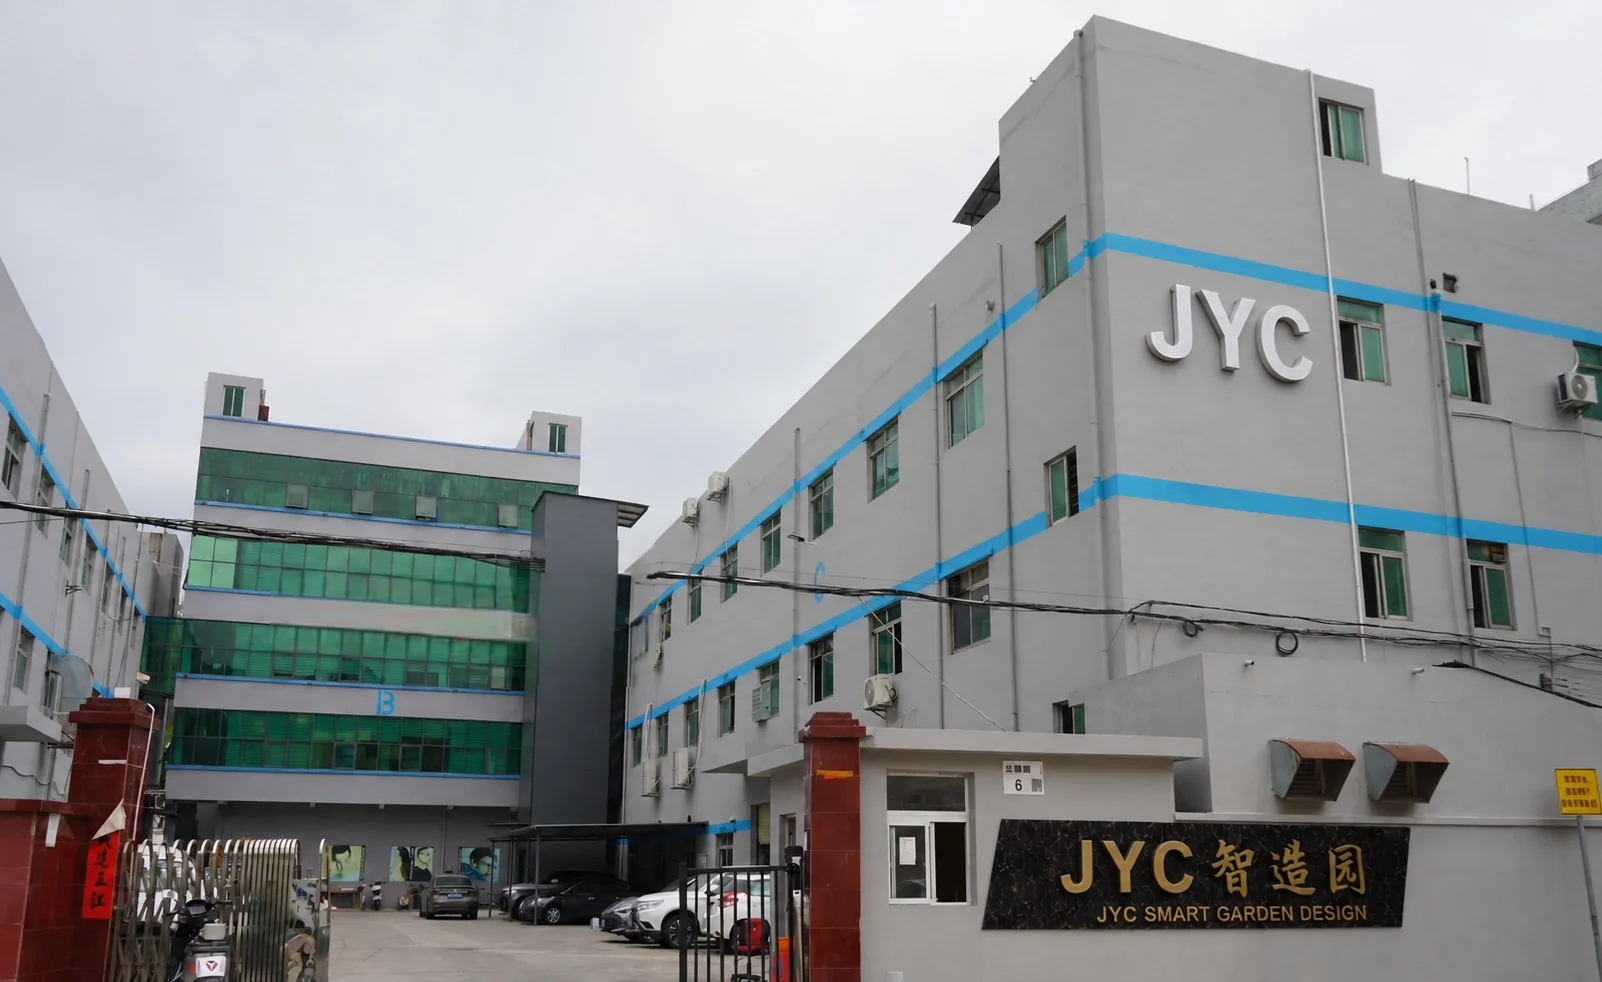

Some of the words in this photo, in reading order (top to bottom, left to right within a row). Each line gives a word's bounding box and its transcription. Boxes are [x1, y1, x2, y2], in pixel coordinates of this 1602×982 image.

[1145, 284, 1313, 382] JYC
[814, 561, 826, 604] C
[377, 690, 396, 716] B
[1015, 779, 1023, 791] 6
[1060, 840, 1194, 894] JYC
[1211, 838, 1366, 897] 智造园
[1097, 906, 1137, 923] JYC
[1145, 906, 1210, 922] SMART
[1216, 905, 1294, 922] GARDEN
[1301, 905, 1367, 921] DESIGN
